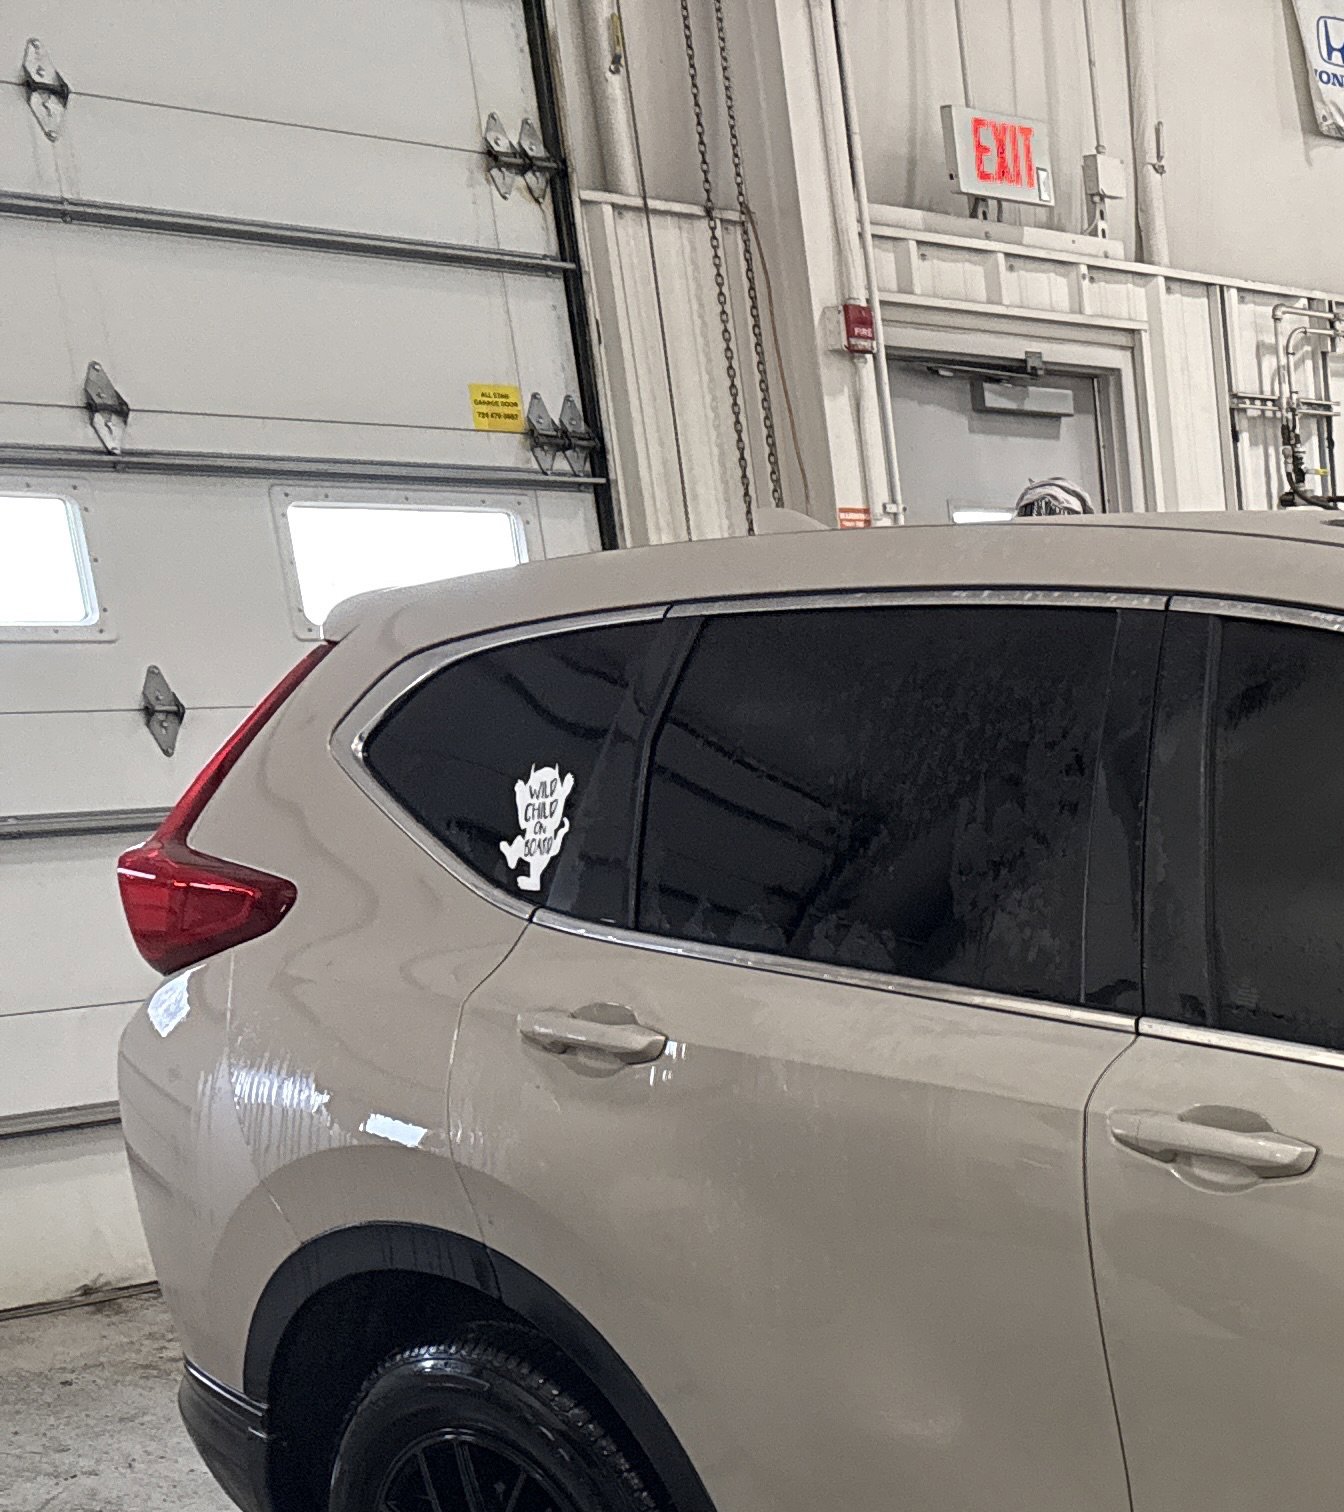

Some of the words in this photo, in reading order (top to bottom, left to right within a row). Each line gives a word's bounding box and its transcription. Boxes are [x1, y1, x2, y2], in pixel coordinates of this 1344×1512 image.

[971, 117, 1034, 189] EXIT
[528, 778, 558, 800] WILD
[524, 799, 558, 823] CHILD
[533, 821, 547, 835] ON
[523, 837, 554, 858] BOARD
